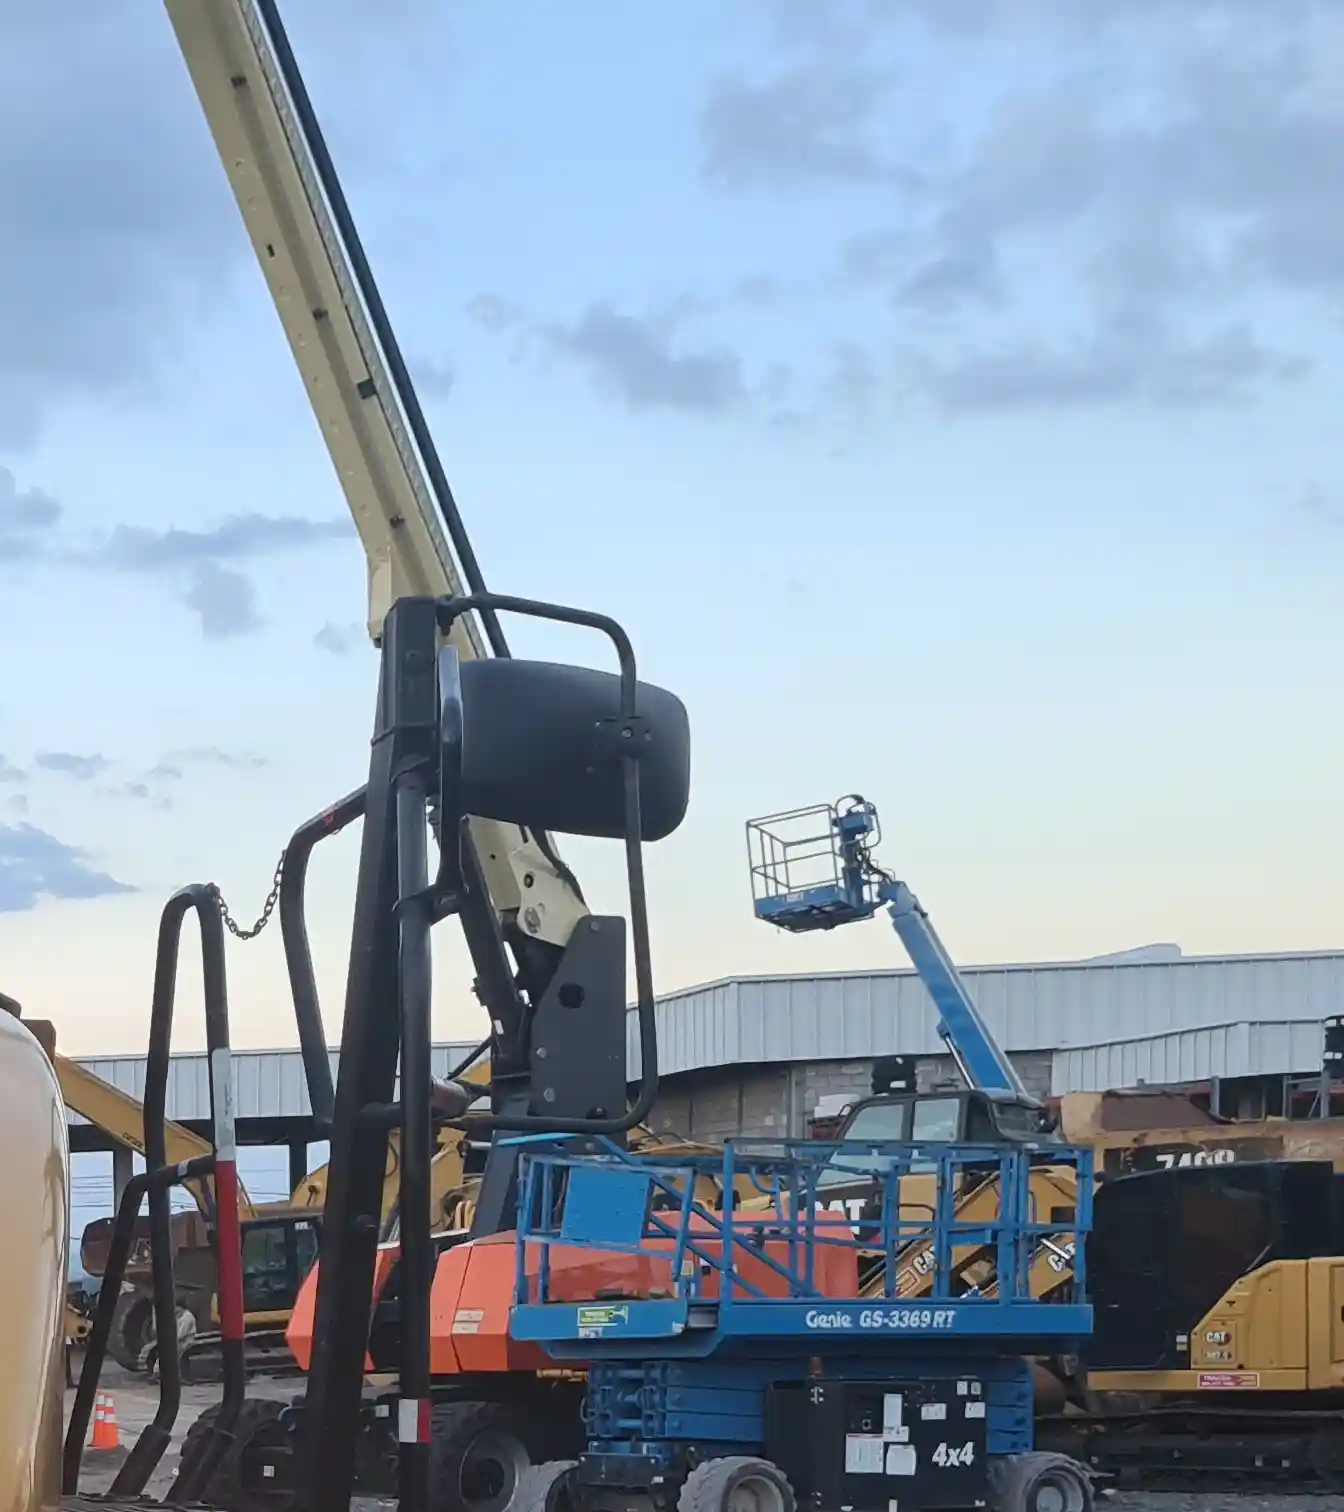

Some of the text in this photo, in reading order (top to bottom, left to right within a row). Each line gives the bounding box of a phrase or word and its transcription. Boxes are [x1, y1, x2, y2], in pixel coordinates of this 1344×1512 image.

[805, 1309, 956, 1329] Genie GS-3369 RT
[1206, 1331, 1226, 1343] CAT
[931, 1441, 975, 1467] 4x4
